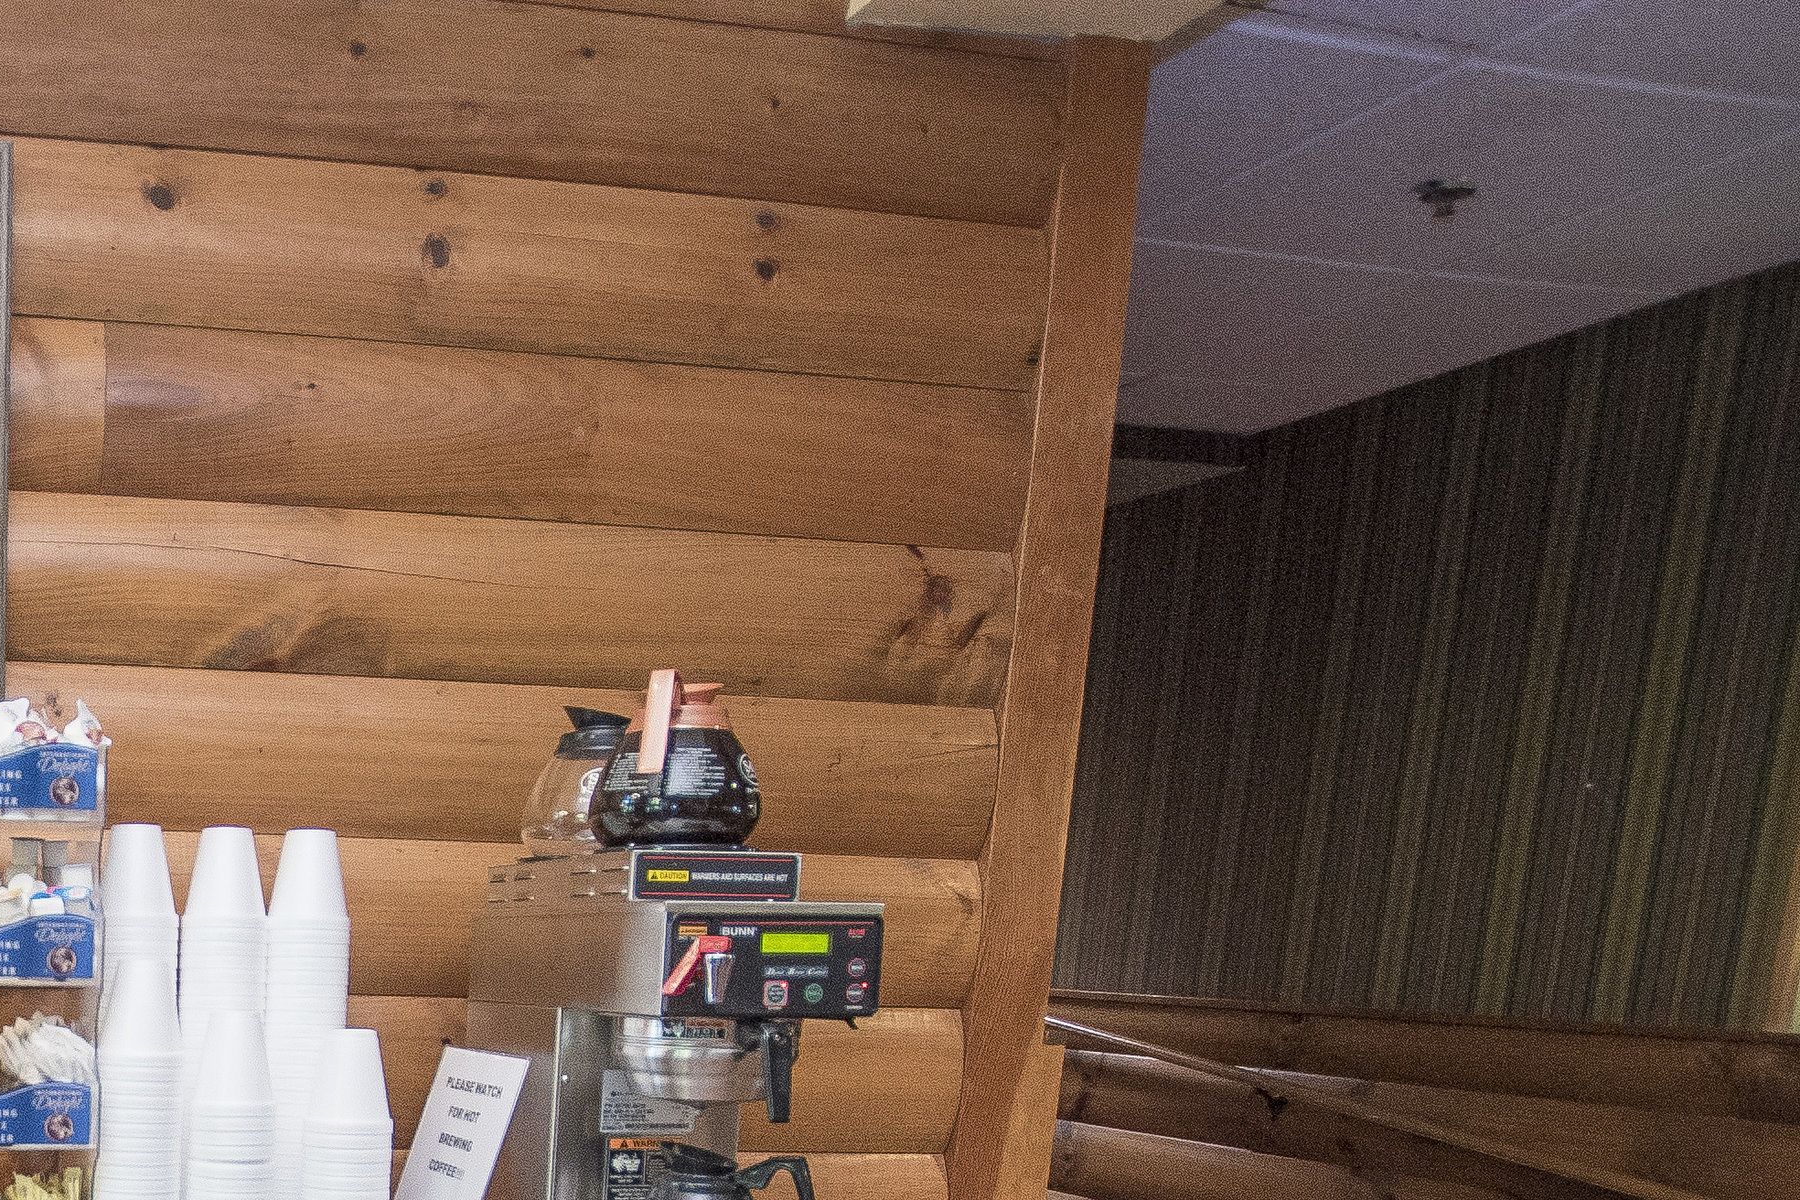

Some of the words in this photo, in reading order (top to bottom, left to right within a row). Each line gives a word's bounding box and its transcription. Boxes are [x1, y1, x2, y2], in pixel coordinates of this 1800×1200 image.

[721, 926, 755, 936] BUNN
[446, 1076, 476, 1094] PLEASE
[475, 1083, 504, 1100] WATCH
[448, 1105, 465, 1119] FOR
[464, 1109, 481, 1124] HOT
[438, 1132, 474, 1152] BREWING
